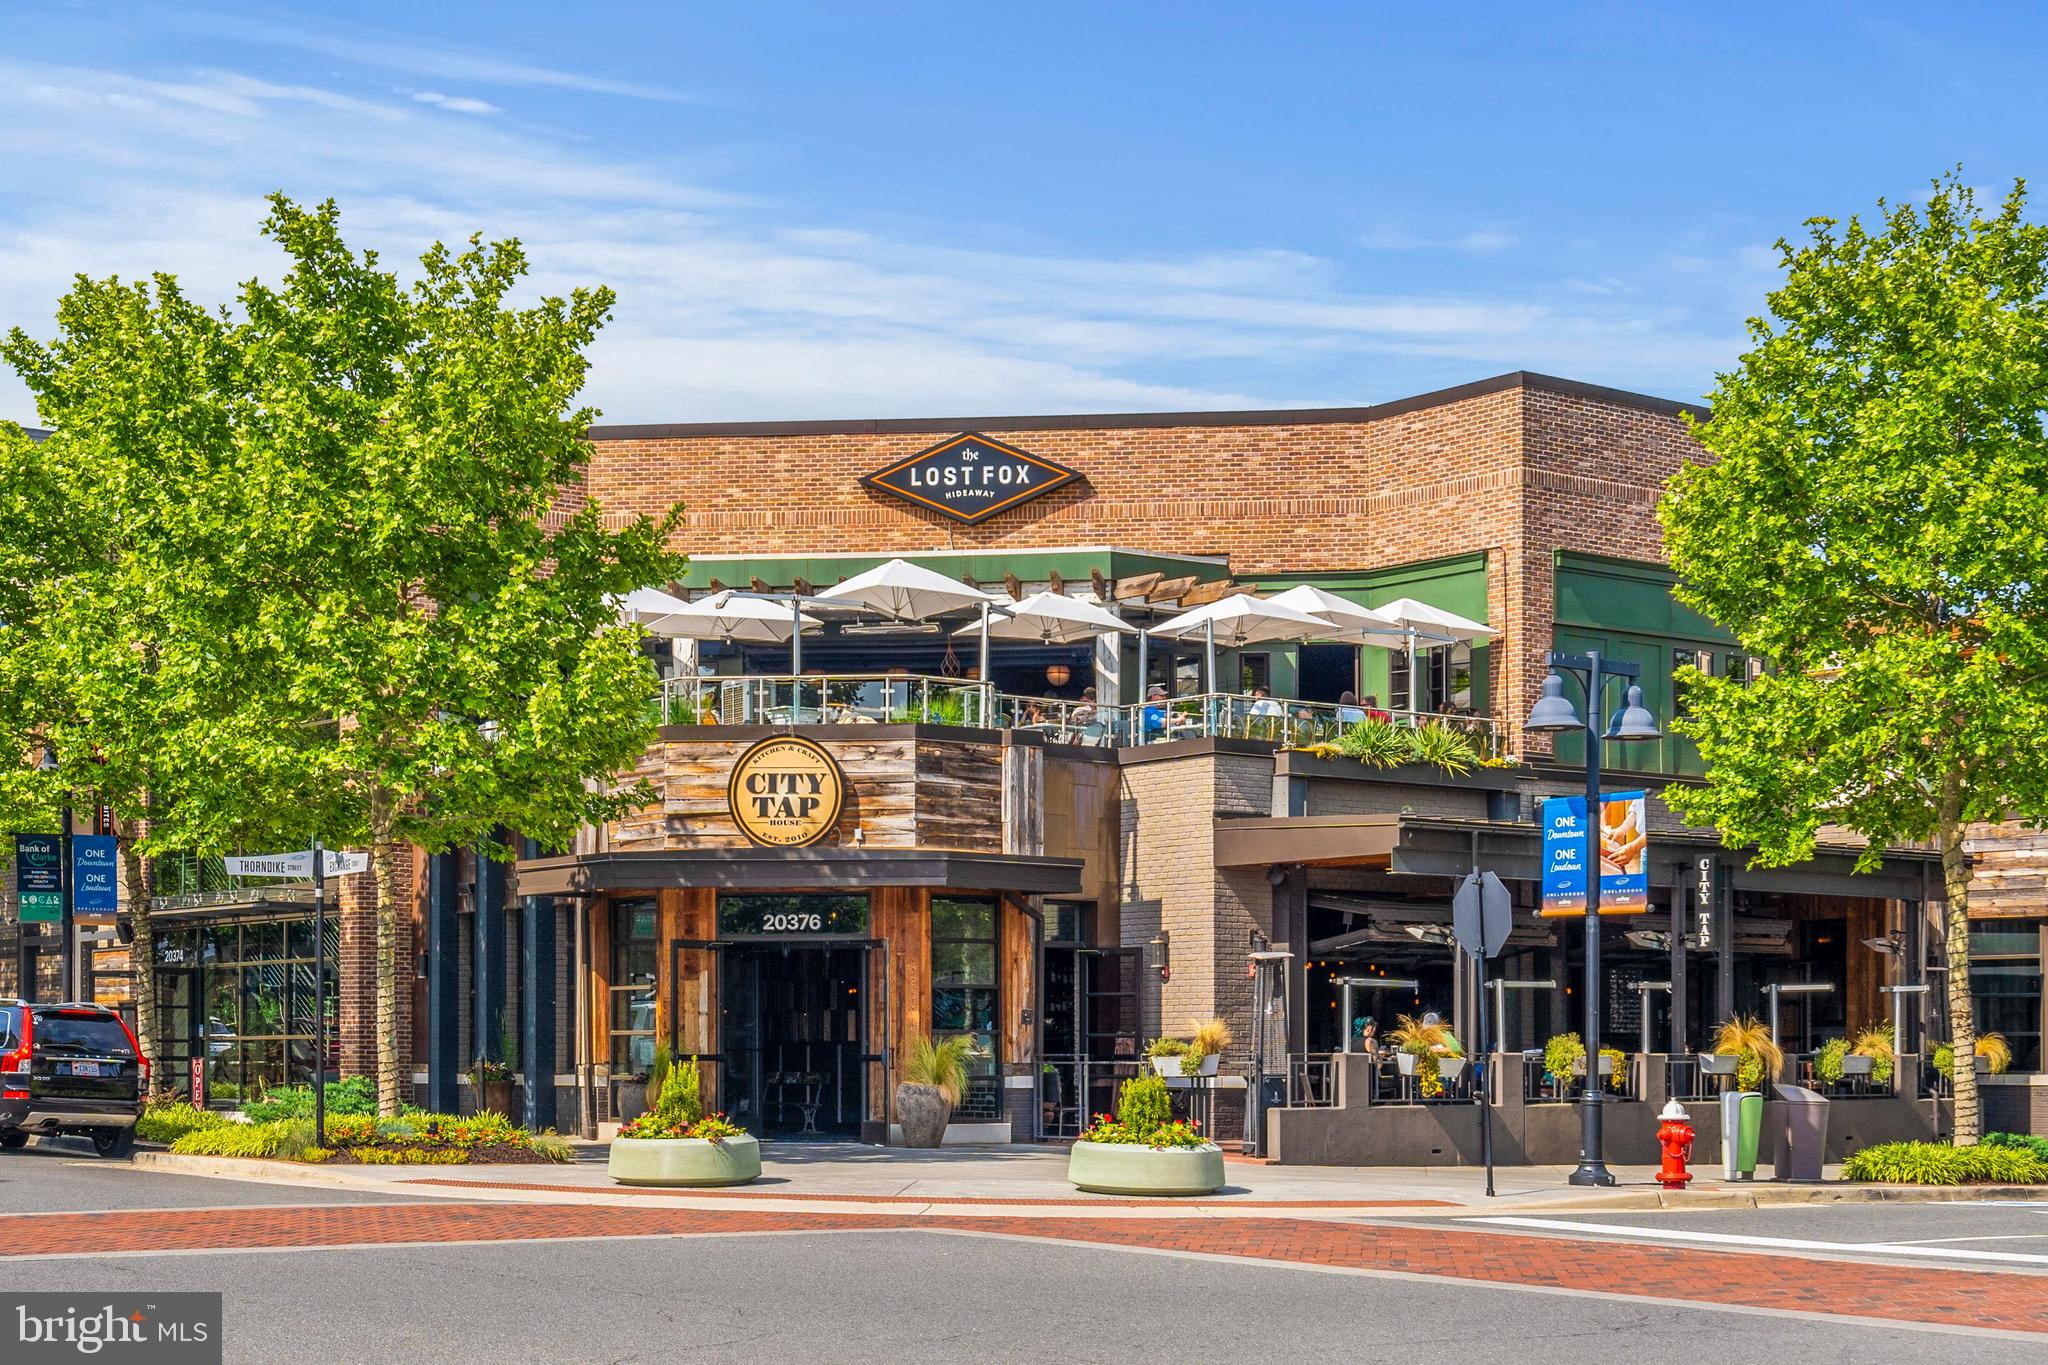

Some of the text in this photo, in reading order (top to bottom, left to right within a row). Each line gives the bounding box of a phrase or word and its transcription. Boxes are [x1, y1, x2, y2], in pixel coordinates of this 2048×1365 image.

[961, 448, 980, 462] the
[910, 464, 1030, 486] LOST FOX
[945, 489, 995, 500] HIDEAWAY
[752, 746, 786, 765] KITCHEN
[797, 746, 821, 764] CRAFT
[745, 773, 828, 795] CITY
[752, 797, 820, 818] TAP
[1555, 816, 1576, 828] ONE
[762, 832, 808, 843] EST. 2010
[1547, 829, 1585, 841] Downtown
[20, 844, 50, 853] Bank of
[85, 849, 105, 858] ONE
[1555, 849, 1576, 860] ONE
[76, 857, 115, 867] Downtown
[240, 860, 285, 873] THORNDIKE
[1550, 861, 1582, 873] Loudoun
[86, 874, 106, 883] ONE
[81, 883, 112, 892] Loudoun
[1698, 859, 1711, 947] CITY TAP
[763, 914, 822, 930] 20376
[164, 950, 184, 962] 20374
